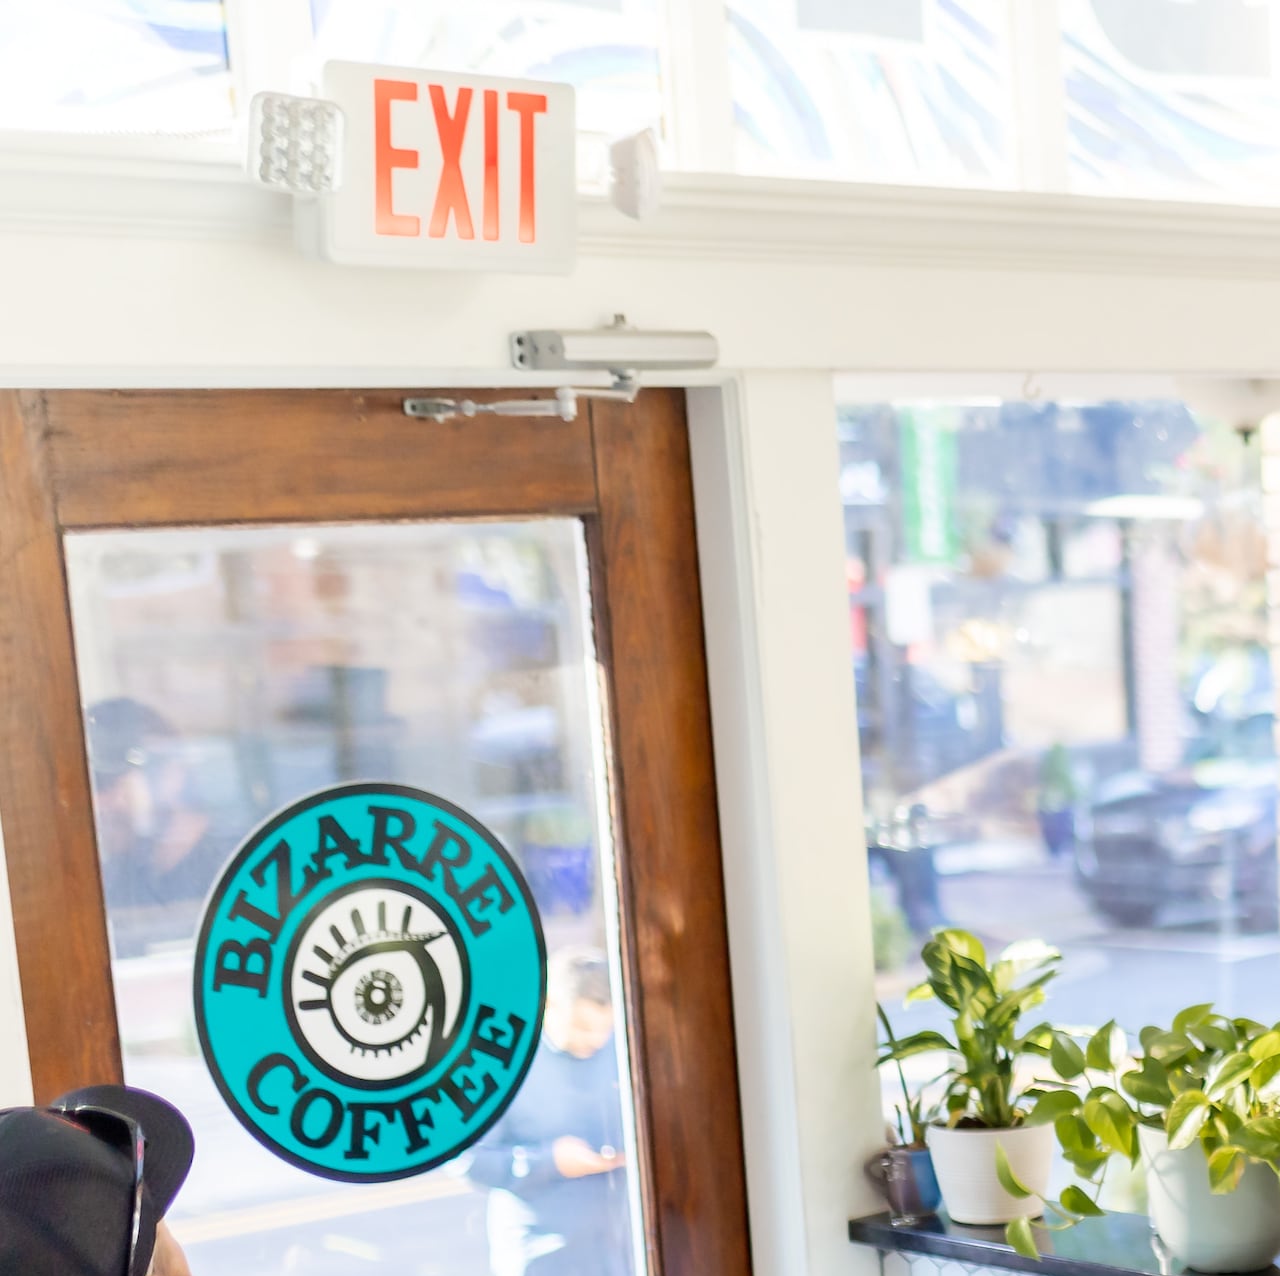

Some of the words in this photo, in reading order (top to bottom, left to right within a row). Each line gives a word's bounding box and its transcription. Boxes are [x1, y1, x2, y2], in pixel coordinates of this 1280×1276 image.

[373, 78, 548, 244] EXIT
[213, 805, 515, 998] BIZARRE
[246, 1003, 527, 1160] COFFEE
